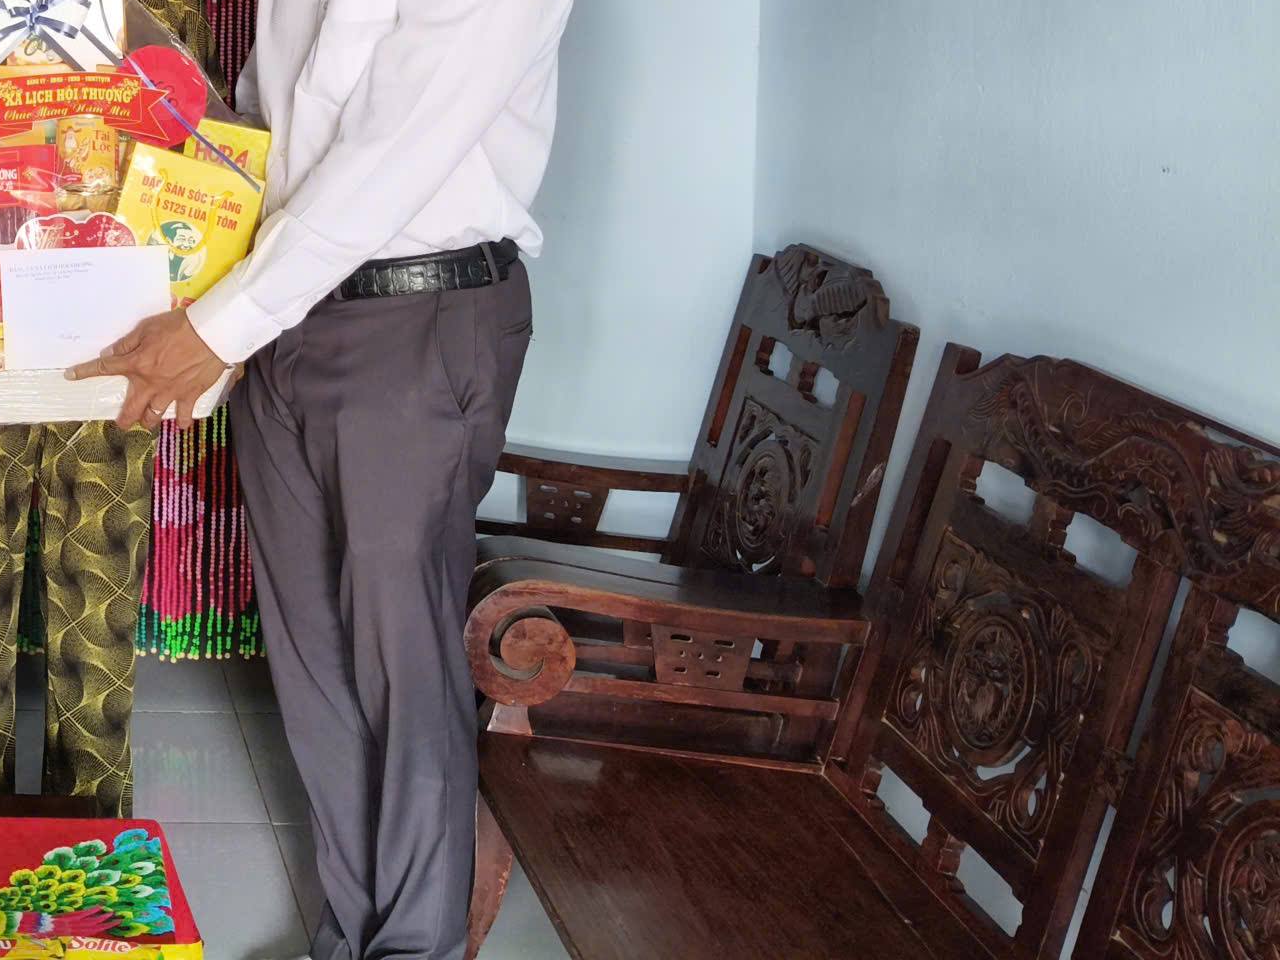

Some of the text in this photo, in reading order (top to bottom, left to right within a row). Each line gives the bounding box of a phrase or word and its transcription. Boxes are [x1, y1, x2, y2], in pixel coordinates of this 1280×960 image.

[187, 189, 208, 204] SÓC
[210, 195, 242, 215] TĂNG
[162, 200, 186, 215] ST25
[188, 205, 207, 222] LÚA
[216, 215, 238, 231] TÔM
[68, 936, 133, 953] Solite
